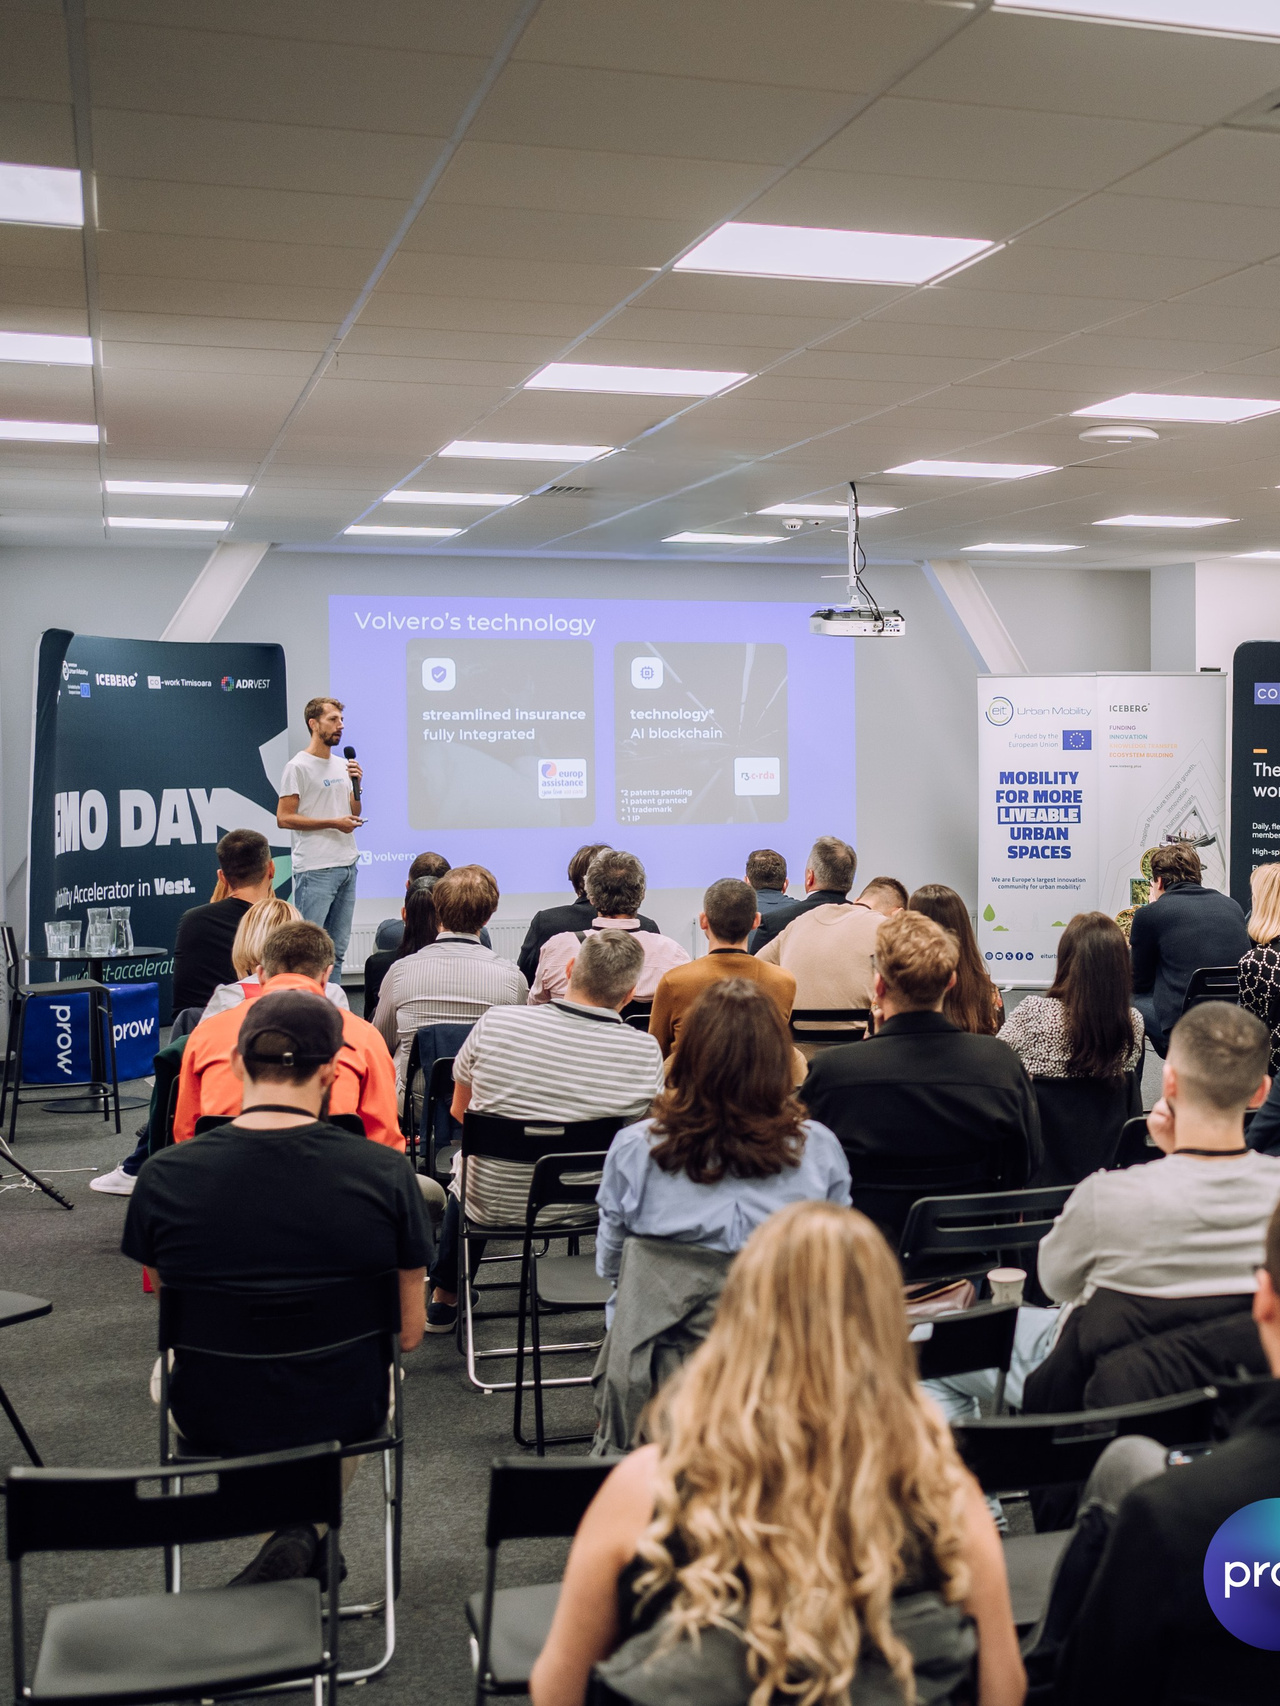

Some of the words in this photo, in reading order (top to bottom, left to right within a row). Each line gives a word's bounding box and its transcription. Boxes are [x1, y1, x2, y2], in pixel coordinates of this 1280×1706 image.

[467, 613, 596, 636] technology
[181, 679, 211, 687] Timisoara
[236, 679, 270, 689] ADRVEST
[422, 708, 511, 721] streamlined
[516, 708, 586, 720] insurance
[1052, 707, 1092, 717] Mobility
[423, 728, 455, 743] fully
[459, 728, 535, 743] Integrated
[630, 727, 645, 739] AI
[649, 727, 723, 739] blockchain
[1039, 733, 1046, 741] by
[559, 771, 583, 779] europ
[999, 771, 1079, 785] MOBILITY
[541, 778, 584, 787] assistance
[630, 789, 659, 797] patents
[661, 788, 693, 797] pending
[996, 790, 1029, 803] FOR
[1033, 790, 1083, 803] MORE
[630, 797, 656, 806] patent
[657, 797, 687, 806] granted
[1146, 813, 1155, 823] the
[1153, 799, 1166, 814] future
[1164, 780, 1182, 800] through
[1167, 787, 1189, 814] innovation
[1000, 808, 1079, 822] LIVEABLE
[1166, 811, 1181, 830] human
[55, 788, 109, 859] EMO
[119, 787, 230, 848] DAY
[1252, 823, 1271, 831] Daily,
[1010, 827, 1069, 841] URBAN
[374, 851, 417, 862] volvero
[1007, 845, 1072, 859] SPACES
[1252, 848, 1280, 857] High-sp
[73, 881, 135, 904] Accelerator
[138, 879, 151, 897] in
[154, 877, 196, 896] Vest.
[113, 1017, 155, 1048] prow
[50, 1005, 72, 1075] prow
